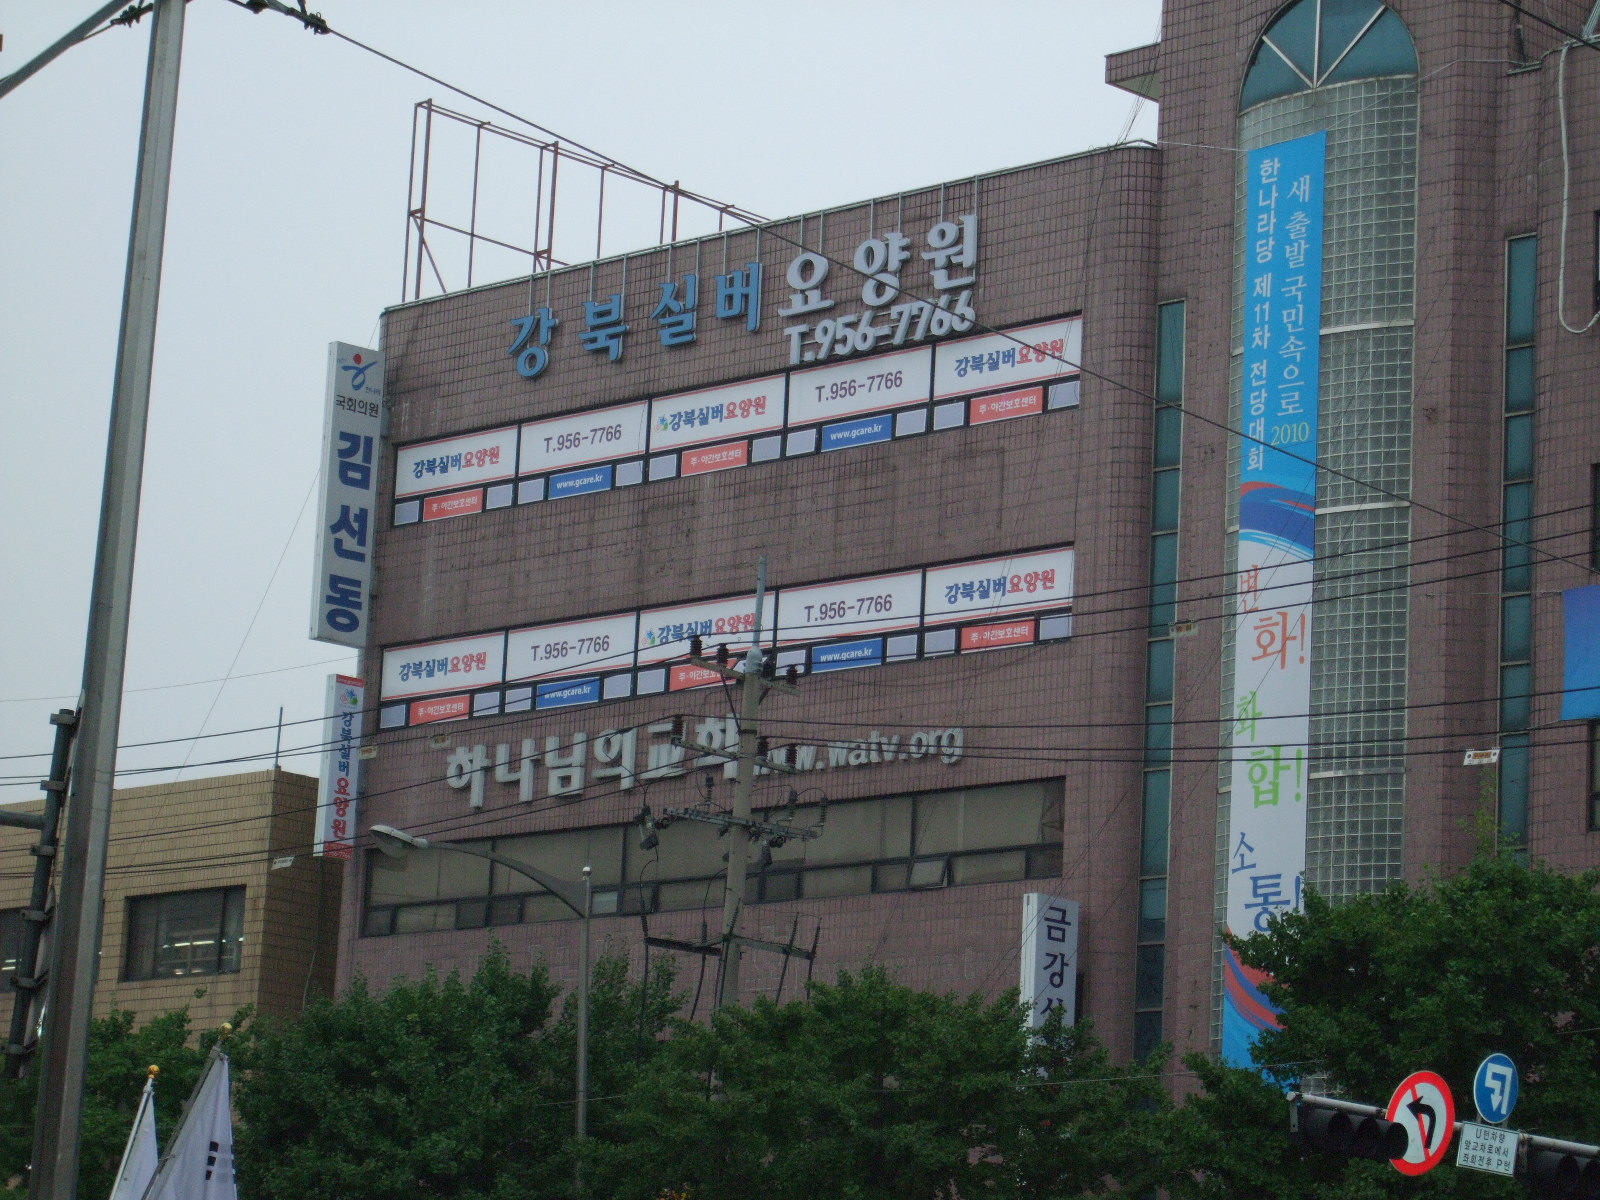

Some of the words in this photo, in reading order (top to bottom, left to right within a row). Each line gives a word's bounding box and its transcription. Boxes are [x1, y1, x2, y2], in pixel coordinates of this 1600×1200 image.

[1255, 157, 1280, 264] 한나라당
[1251, 272, 1272, 351] 제11차
[783, 290, 977, 366] T.956-7766
[1276, 275, 1308, 416] 국민속으로
[815, 370, 904, 403] T.956-7766
[335, 394, 379, 418] 국회의원
[1246, 360, 1268, 471] 전당대회
[543, 424, 622, 454] T.956-7766
[829, 422, 882, 441] www.gcare.kr
[1270, 422, 1310, 447] 2010
[556, 472, 604, 490] www.gcare.kr
[325, 431, 374, 633] 김선동
[804, 594, 893, 624] T.956-7766
[530, 634, 610, 662] T.956-7766
[820, 646, 873, 663] www.gcare.kr
[543, 685, 591, 701] www.gcare.kr
